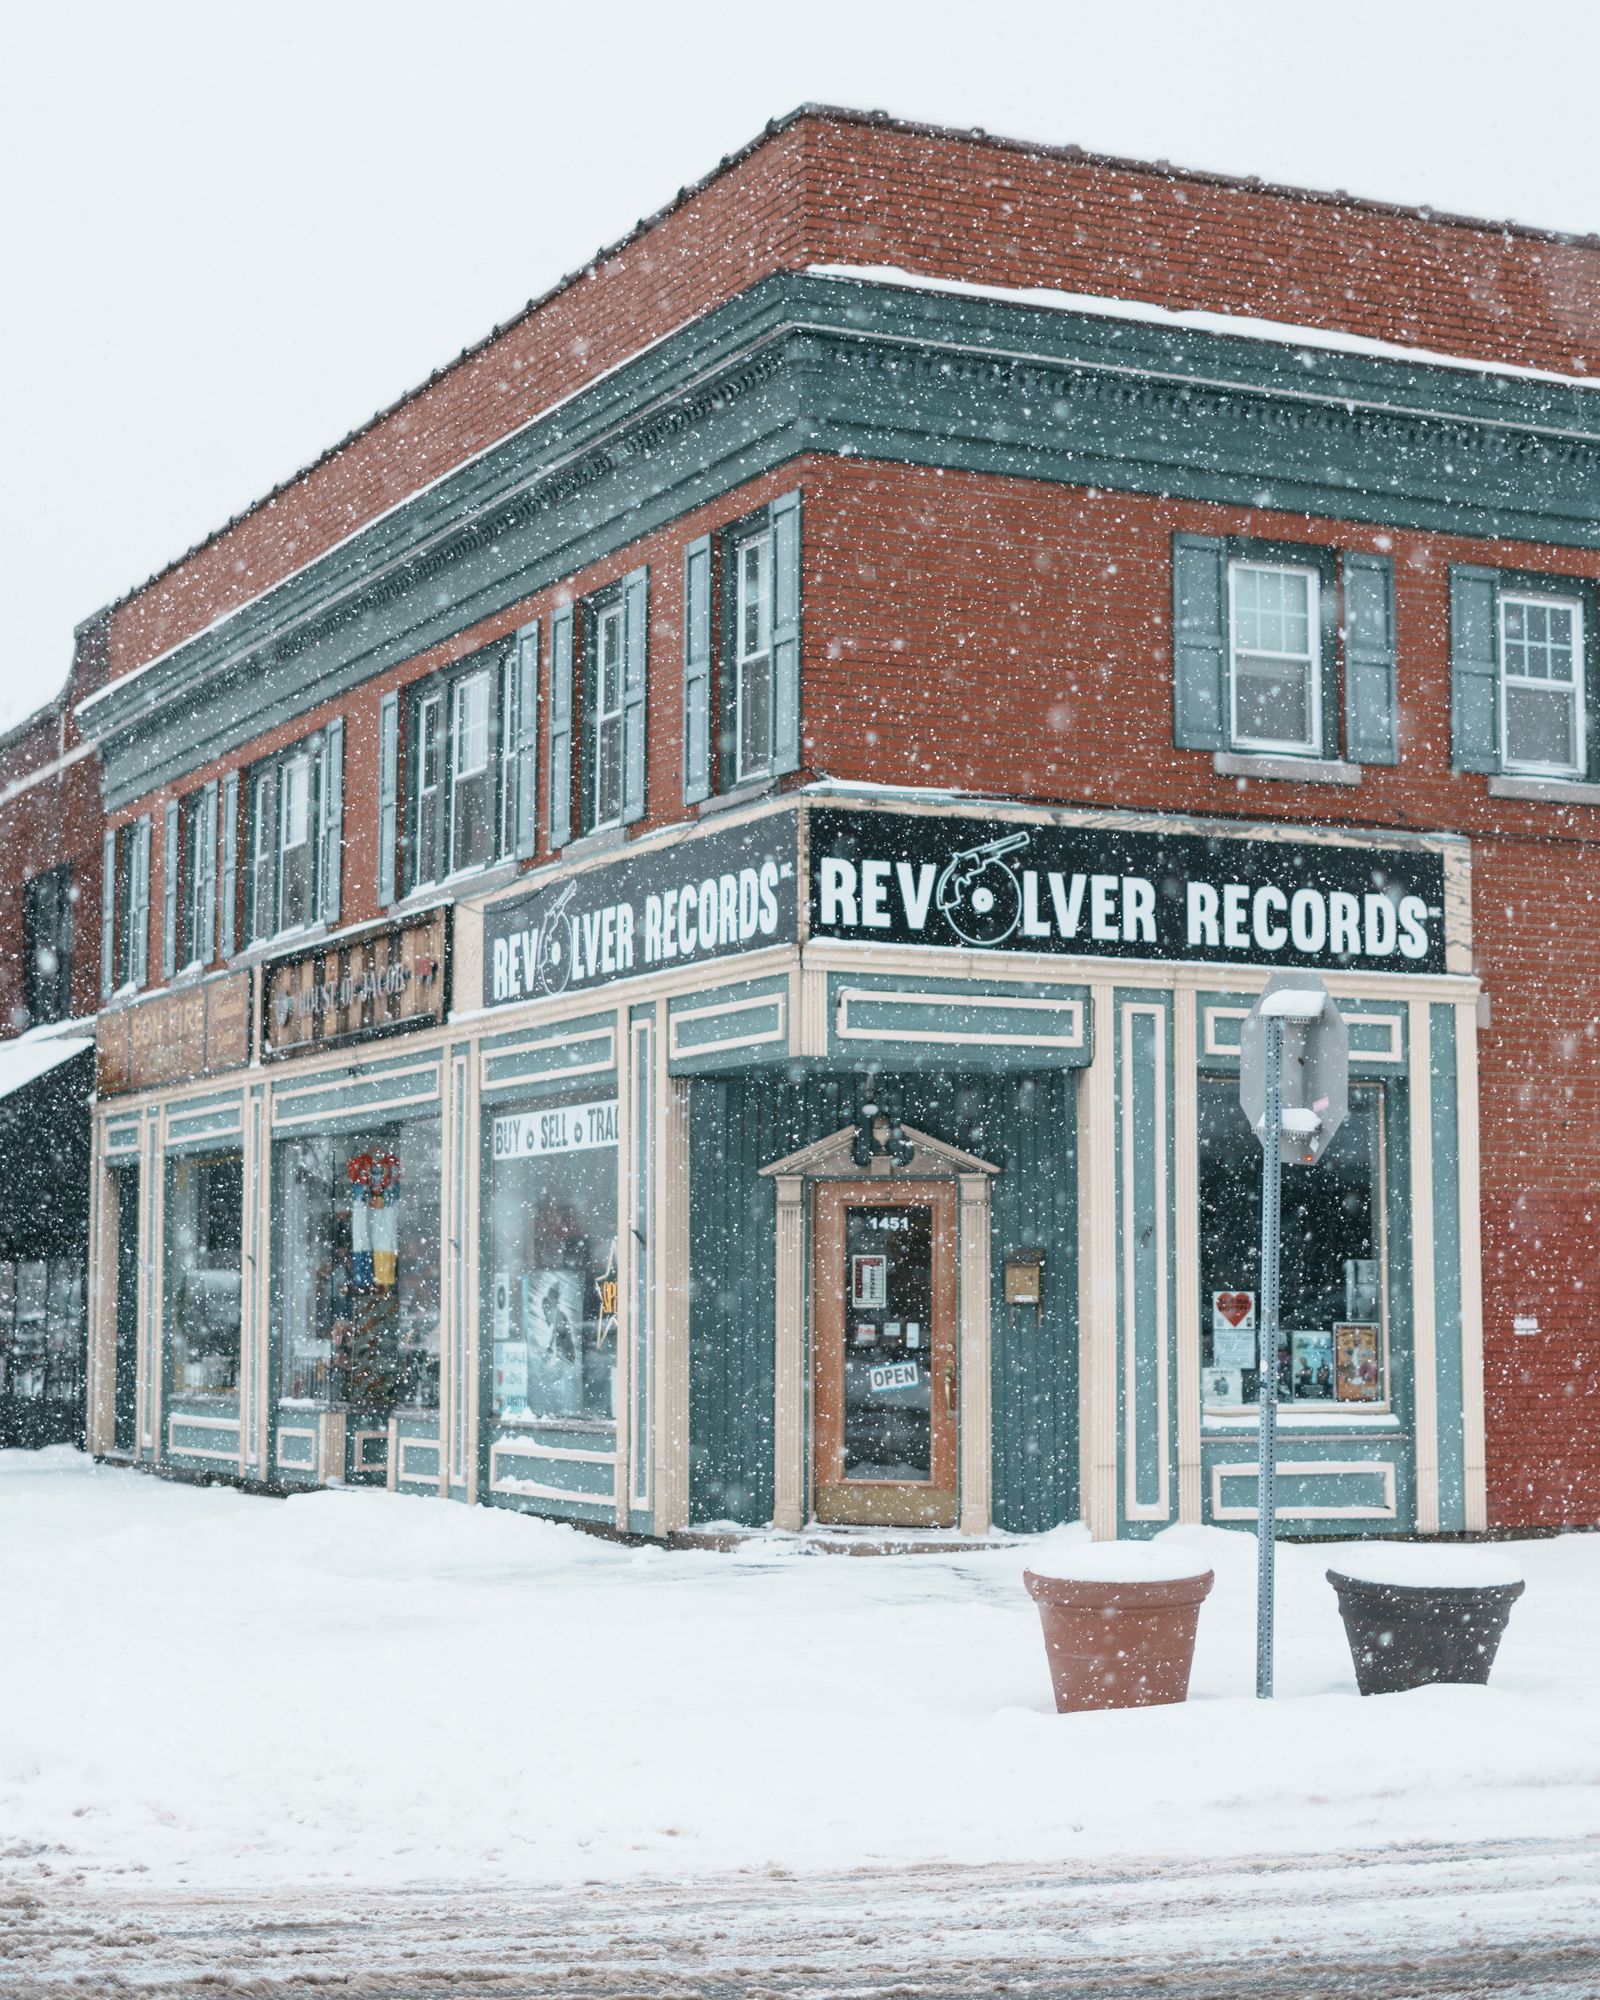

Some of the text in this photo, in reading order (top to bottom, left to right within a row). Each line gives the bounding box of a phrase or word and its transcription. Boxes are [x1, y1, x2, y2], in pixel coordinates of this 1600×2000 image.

[645, 862, 779, 961] RECORDS
[1186, 881, 1428, 959] RECORDS
[495, 1119, 521, 1155] BUY
[541, 1113, 568, 1149] SELL
[869, 1217, 909, 1231] 1451
[873, 1366, 915, 1388] OPEN
